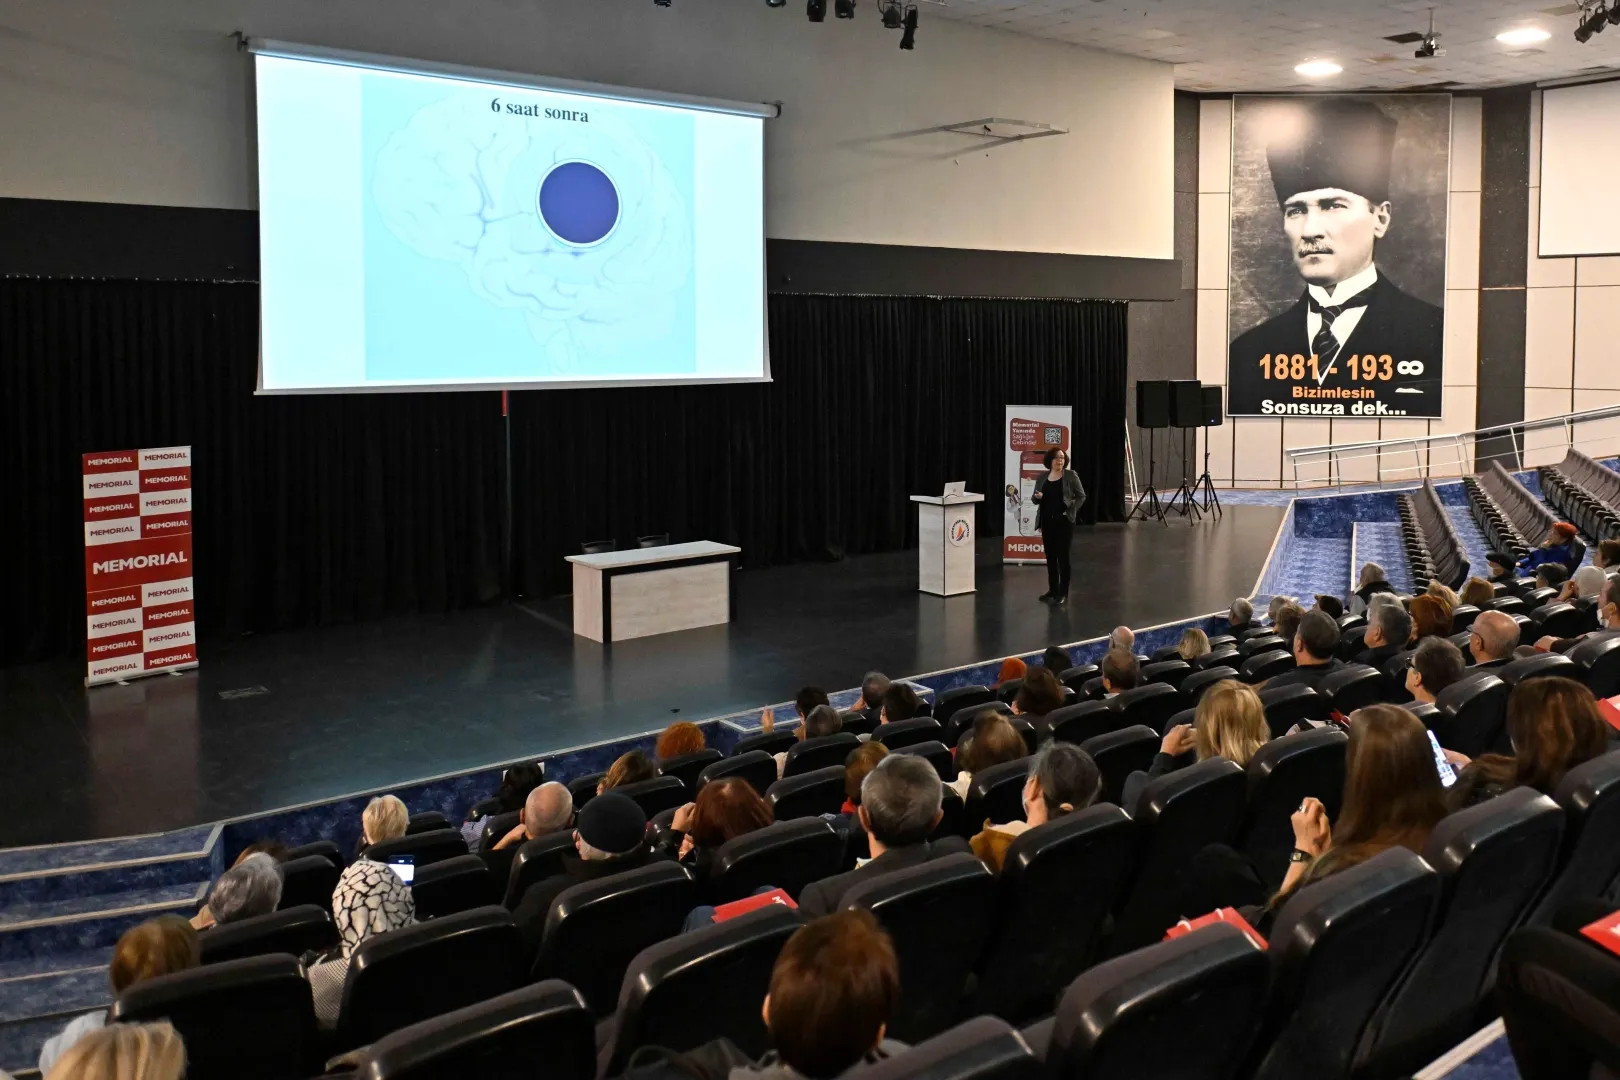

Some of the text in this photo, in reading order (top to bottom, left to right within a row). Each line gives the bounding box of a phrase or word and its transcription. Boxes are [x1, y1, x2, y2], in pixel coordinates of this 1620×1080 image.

[491, 97, 589, 122] 6 saat sonra
[1259, 353, 1319, 380] 1881
[1292, 386, 1375, 399] Bizimlesin
[1261, 399, 1407, 415] Sonsuza dek...
[88, 456, 132, 466] MEMORIAL
[144, 452, 187, 461] MEMORIAL
[88, 480, 133, 489] MEMORIAL
[145, 475, 188, 484] MEMORIAL
[89, 503, 134, 513] MEMORIAL
[145, 497, 188, 507] MEMORIAL
[90, 526, 134, 536] MEMORIAL
[146, 520, 188, 530] MEMORIAL
[93, 551, 188, 575] MEMORIAL
[148, 586, 189, 598] MEMORIAL
[92, 594, 136, 607] MEMORIAL
[148, 608, 190, 620] MEMORIAL
[92, 618, 136, 630] MEMORIAL
[149, 631, 191, 643] MEMORIAL
[93, 640, 137, 653] MEMORIAL
[149, 652, 192, 666] MEMORIAL
[93, 663, 137, 675] MEMORIAL
